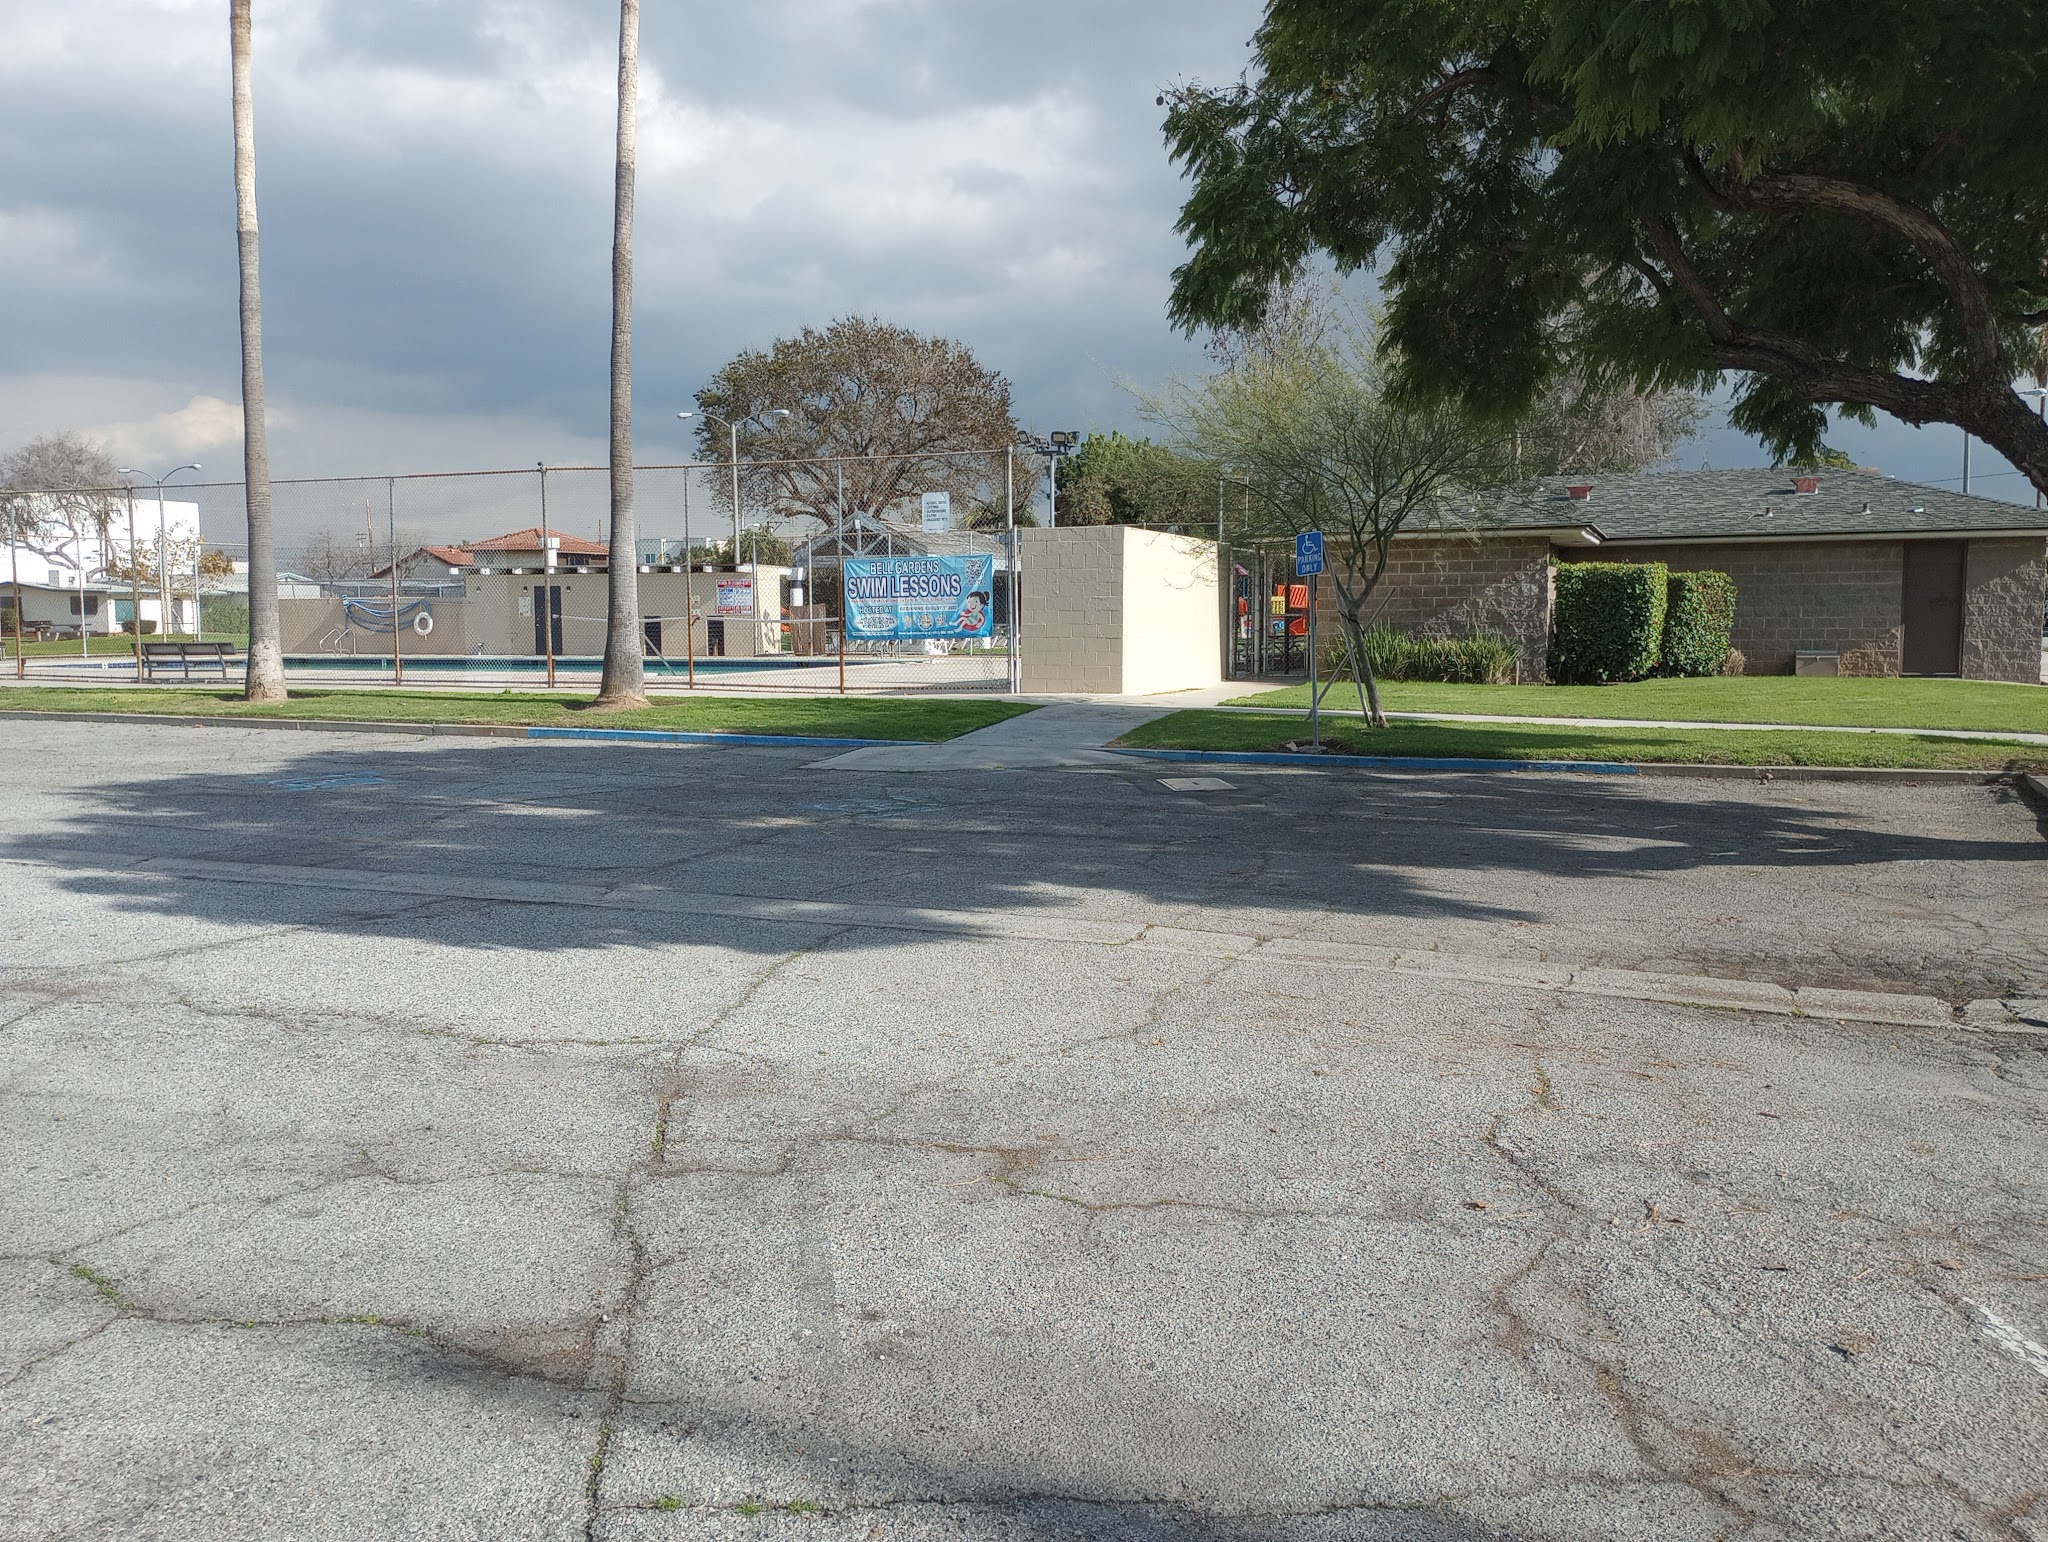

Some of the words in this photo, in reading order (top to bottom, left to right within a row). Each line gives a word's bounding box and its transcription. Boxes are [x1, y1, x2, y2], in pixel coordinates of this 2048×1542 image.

[1298, 552, 1321, 564] PARKING
[870, 562, 893, 575] BELL
[895, 560, 940, 574] GARDENS
[1302, 563, 1317, 573] ONLY
[848, 576, 887, 598] SWIM
[891, 574, 961, 598] LESSONS
[860, 606, 884, 614] HOSTED
[884, 605, 893, 614] AT
